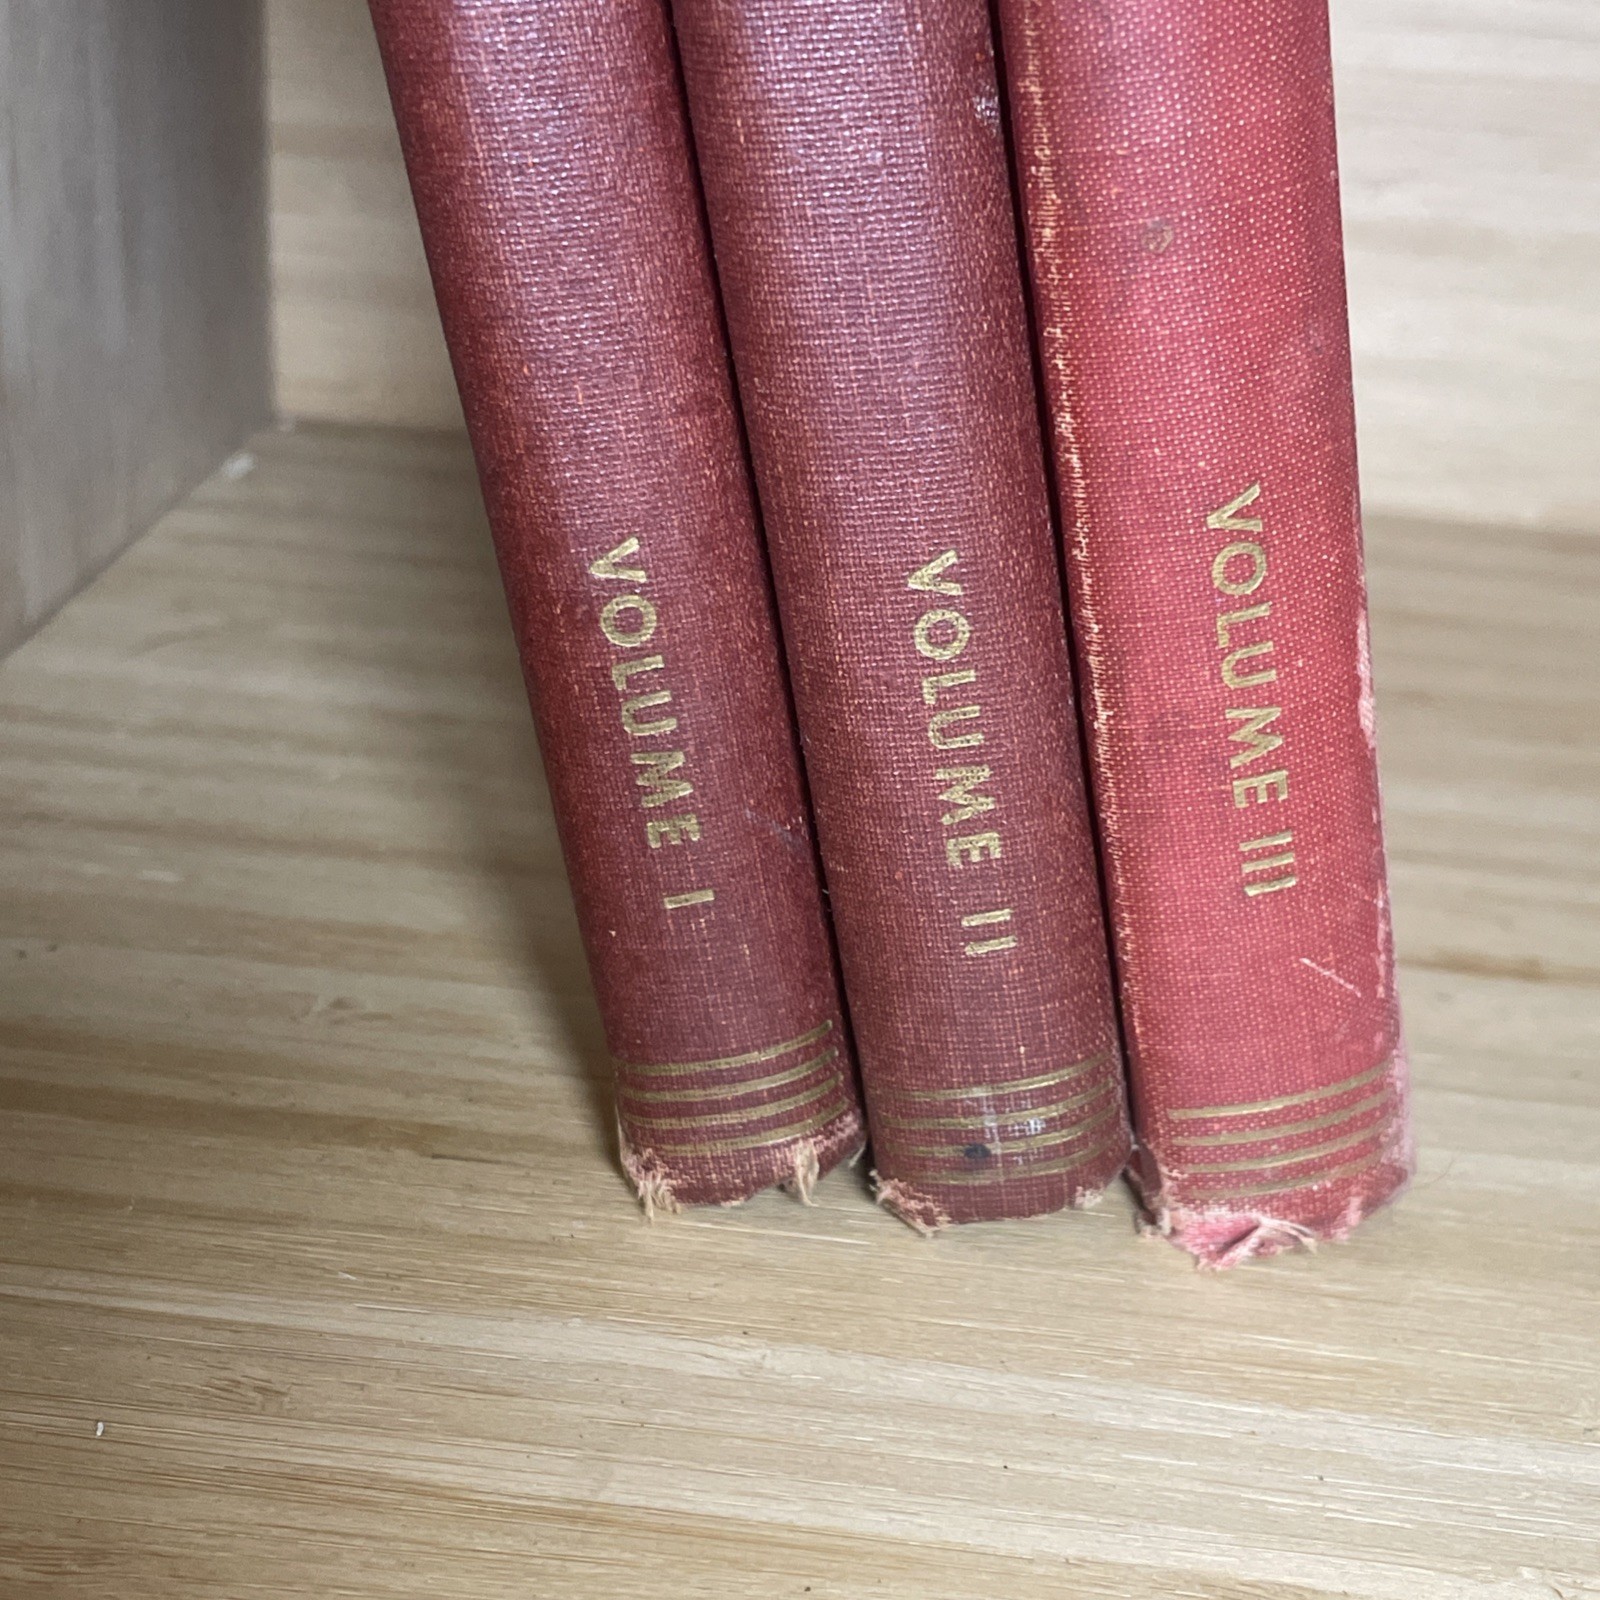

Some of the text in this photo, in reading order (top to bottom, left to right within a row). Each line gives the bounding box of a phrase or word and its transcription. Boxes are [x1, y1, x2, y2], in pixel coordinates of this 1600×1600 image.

[589, 537, 715, 910] VOLUME I
[907, 549, 1018, 956] VOLUME II
[1205, 484, 1296, 897] VOLUME III
